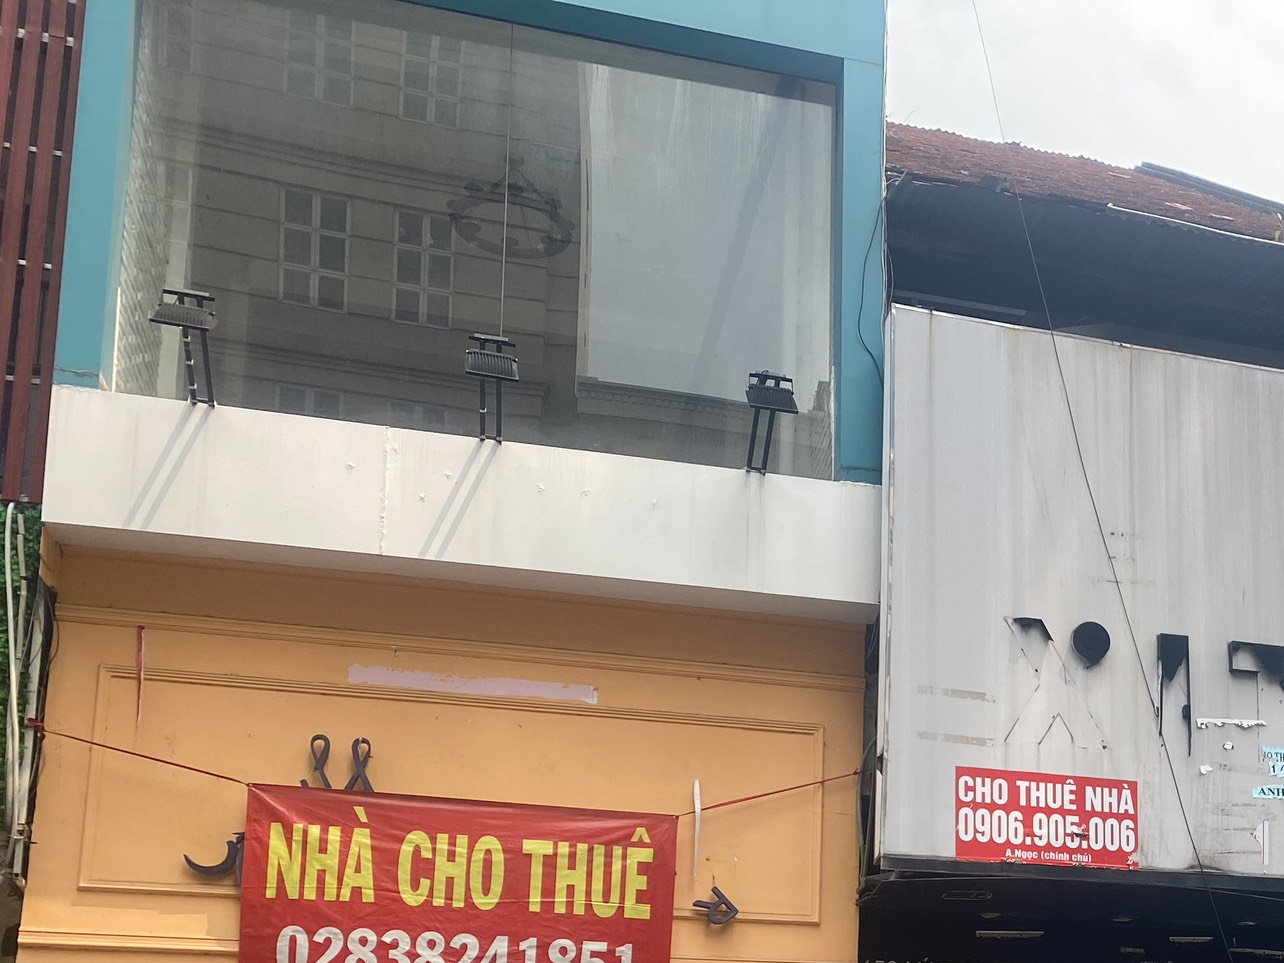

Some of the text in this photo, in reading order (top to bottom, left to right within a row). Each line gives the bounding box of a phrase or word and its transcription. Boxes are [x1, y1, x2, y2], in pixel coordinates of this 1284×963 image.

[958, 775, 1135, 815] CHO THUÊ NHÀ
[1258, 787, 1284, 797] ANH
[957, 807, 1136, 853] 0906.905.006
[265, 806, 375, 903] NHÀ
[399, 829, 506, 911] CHO
[522, 827, 655, 920] THUÊ
[1005, 849, 1038, 861] A.Ngọc
[1041, 850, 1070, 862] (chính
